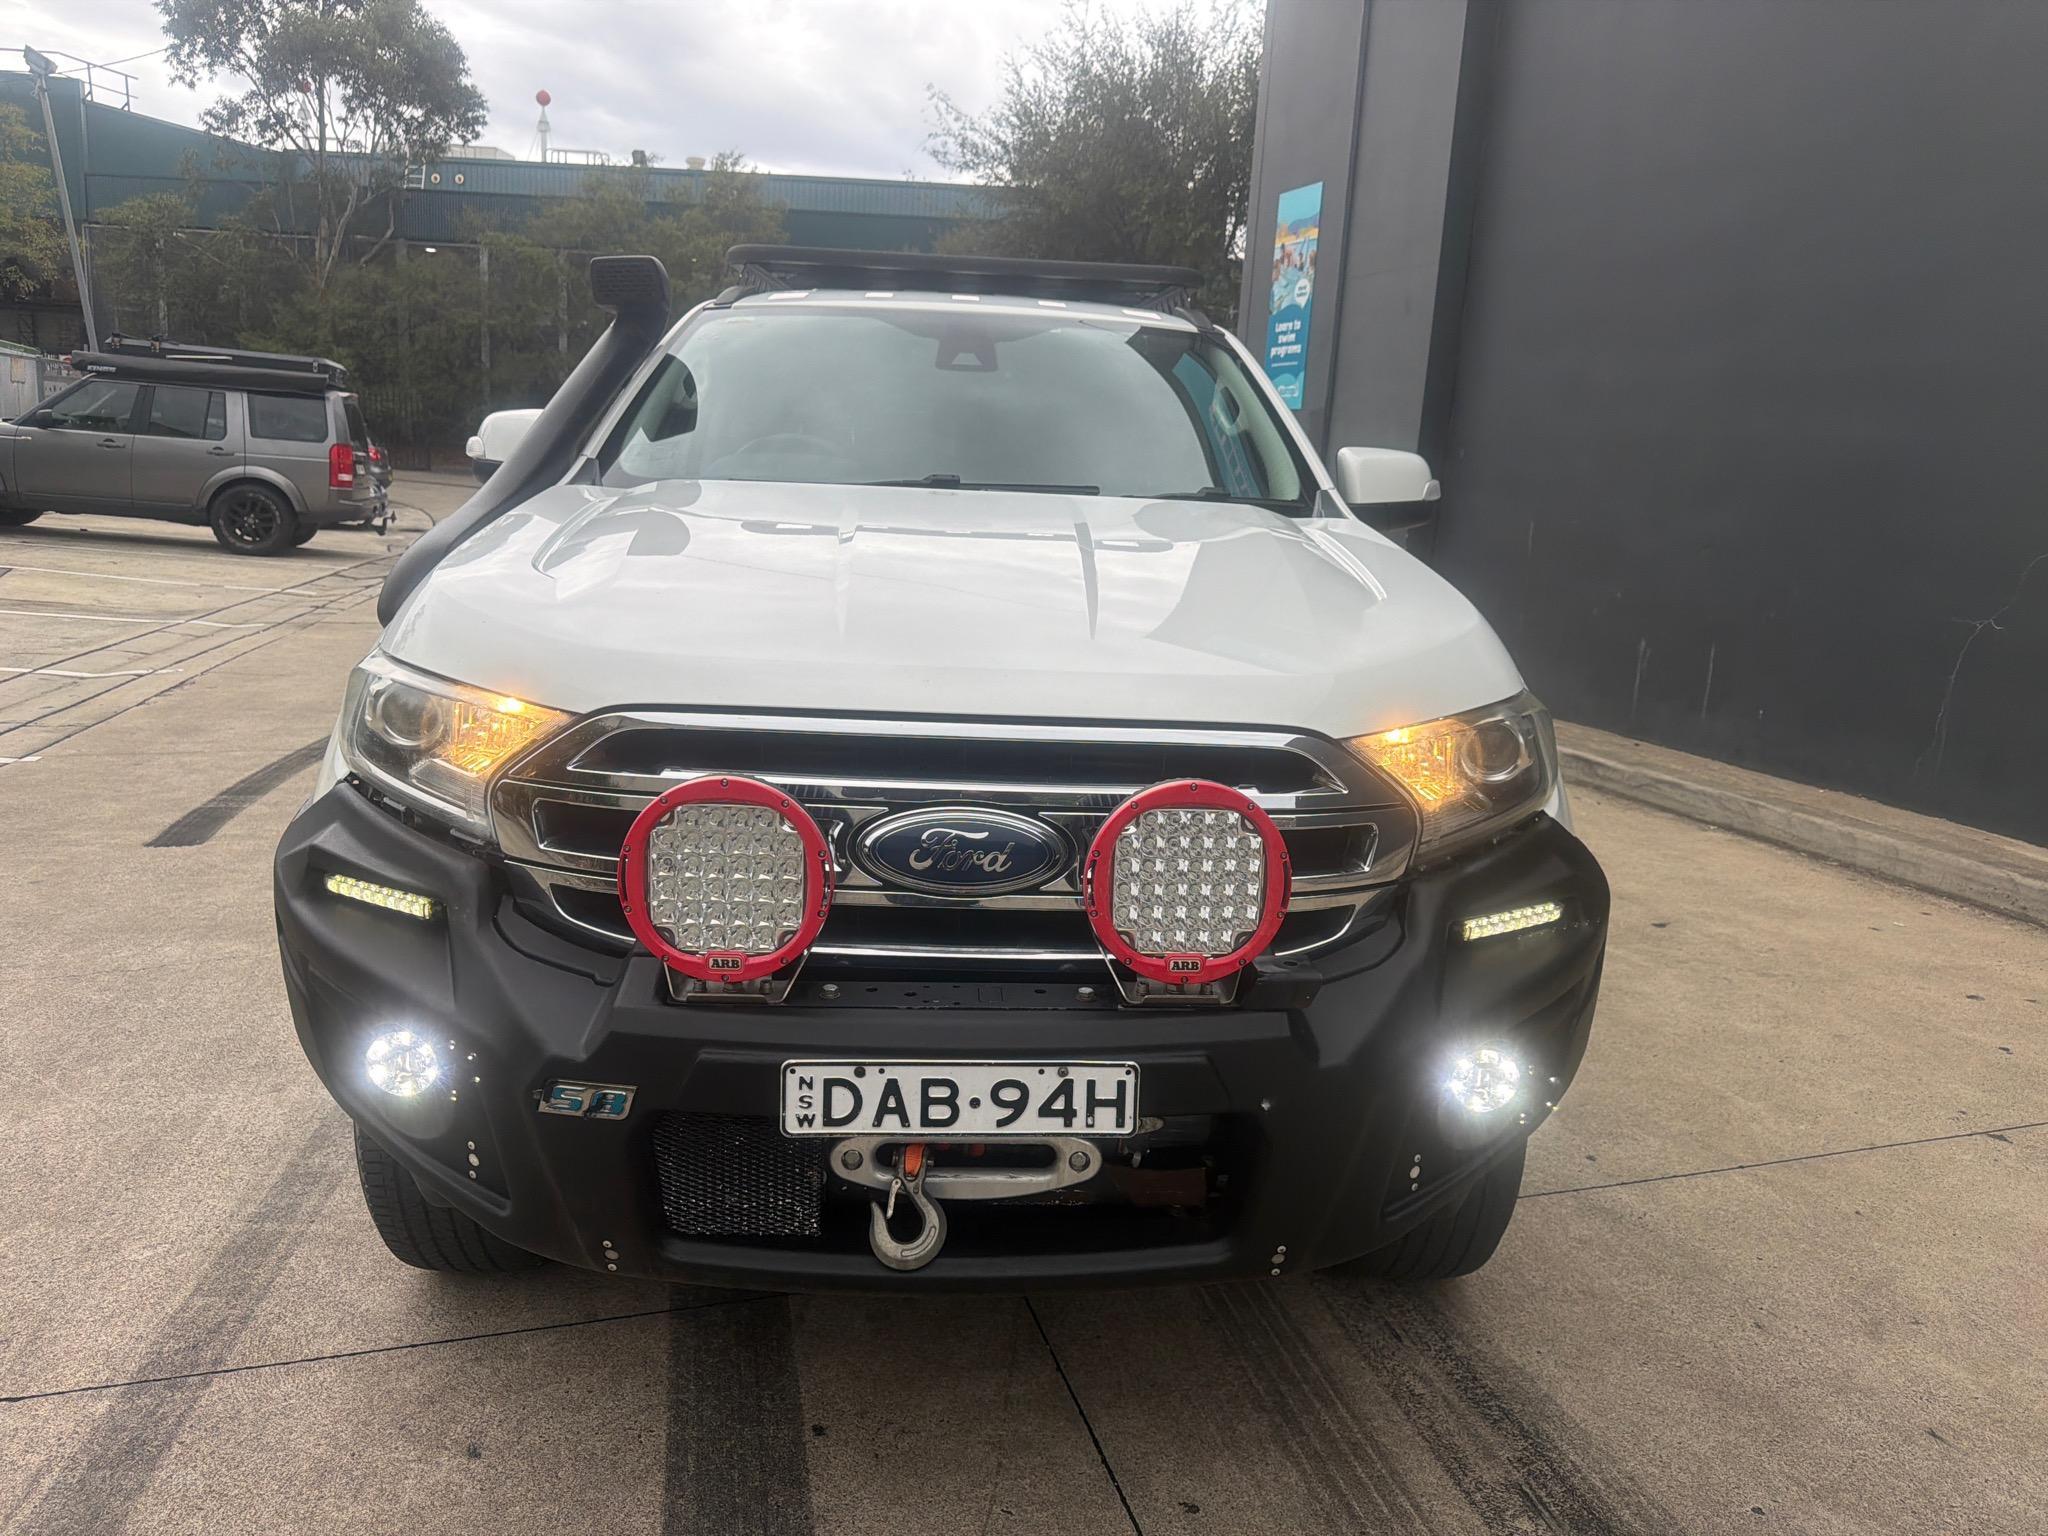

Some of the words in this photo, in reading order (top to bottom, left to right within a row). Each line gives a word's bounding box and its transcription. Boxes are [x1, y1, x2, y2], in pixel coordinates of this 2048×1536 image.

[1275, 321, 1293, 332] Learn
[1293, 319, 1301, 330] to
[1278, 331, 1296, 343] swim
[908, 827, 1015, 872] Ford
[711, 958, 740, 968] ARB
[1172, 961, 1200, 971] ARB
[796, 1075, 816, 1128] NSW
